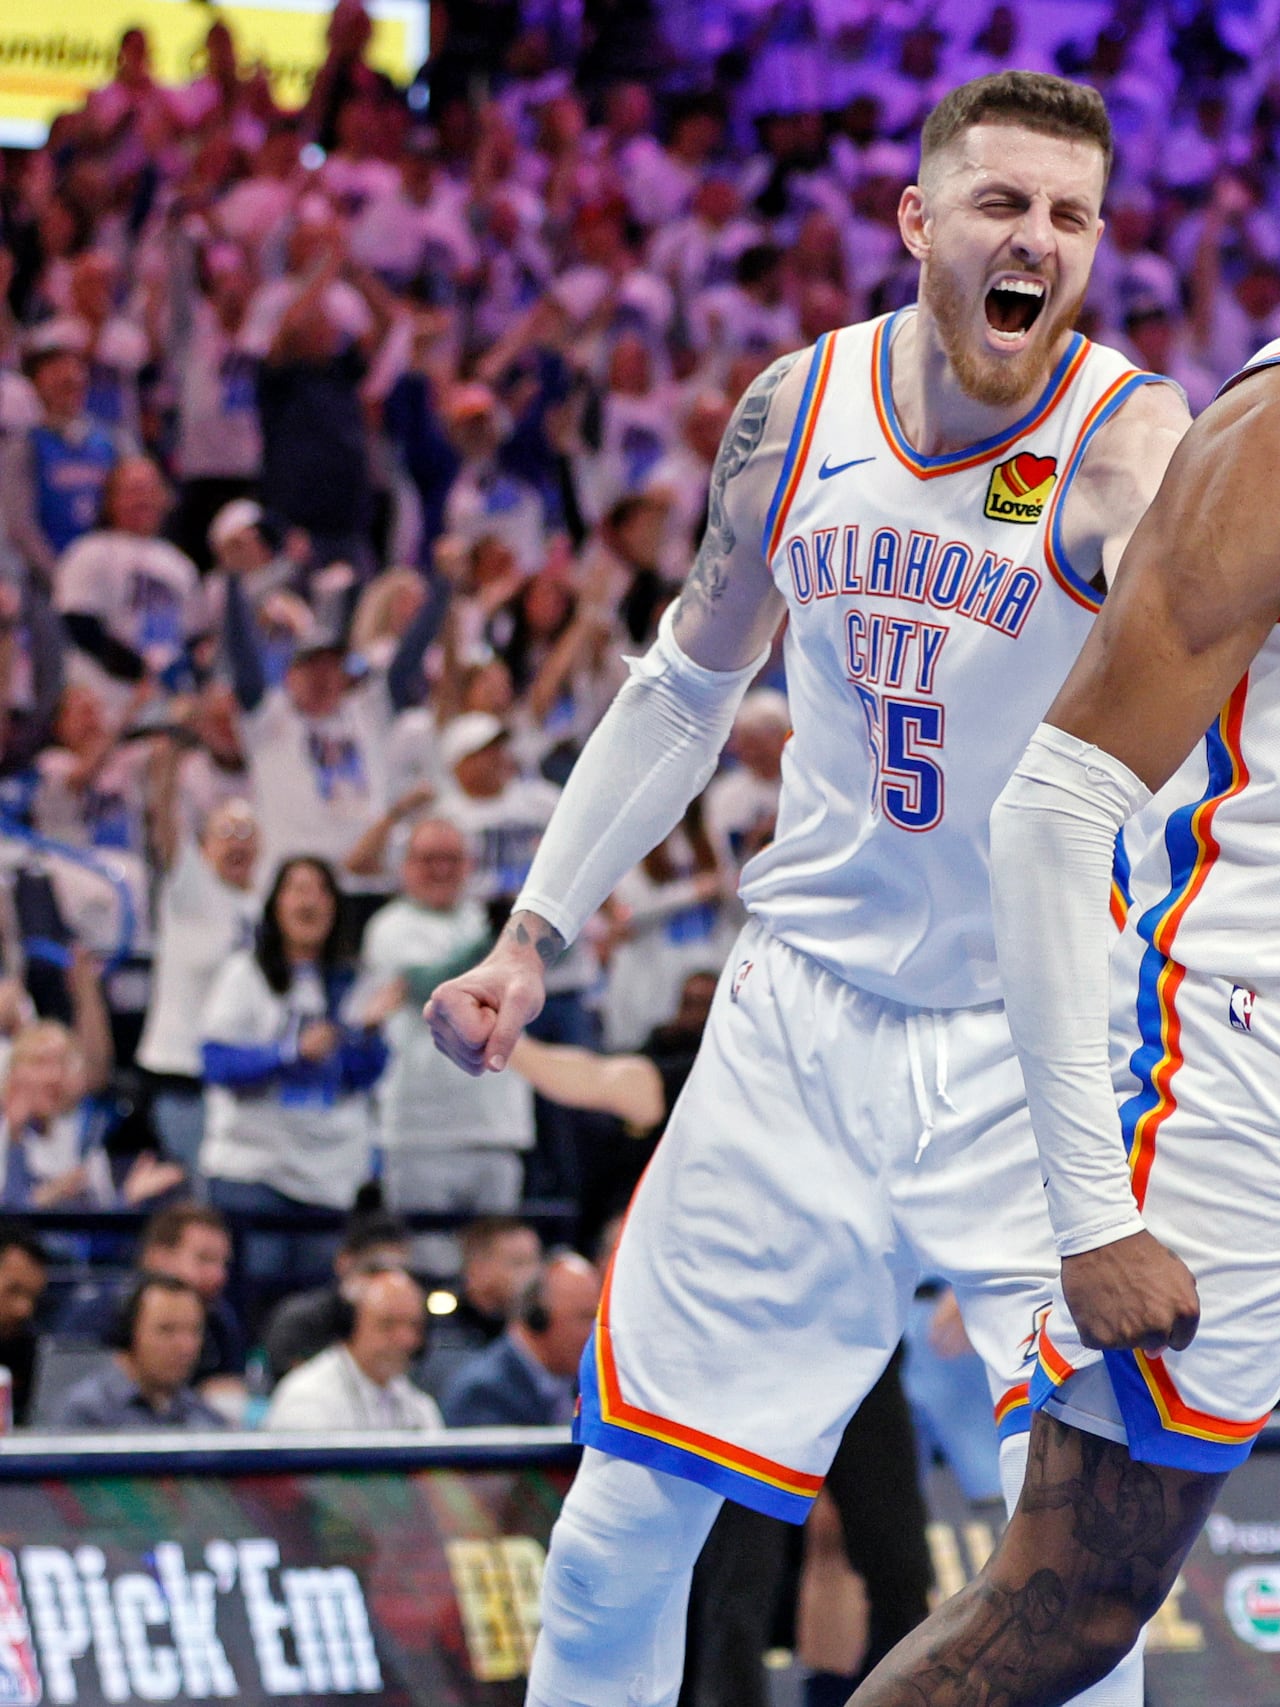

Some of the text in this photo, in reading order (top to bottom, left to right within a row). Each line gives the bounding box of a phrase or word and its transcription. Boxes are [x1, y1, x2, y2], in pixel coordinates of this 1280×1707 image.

[788, 524, 1042, 639] OKLAHOMA
[845, 609, 950, 694] CITY
[21, 1538, 384, 1703] Pick'Em
